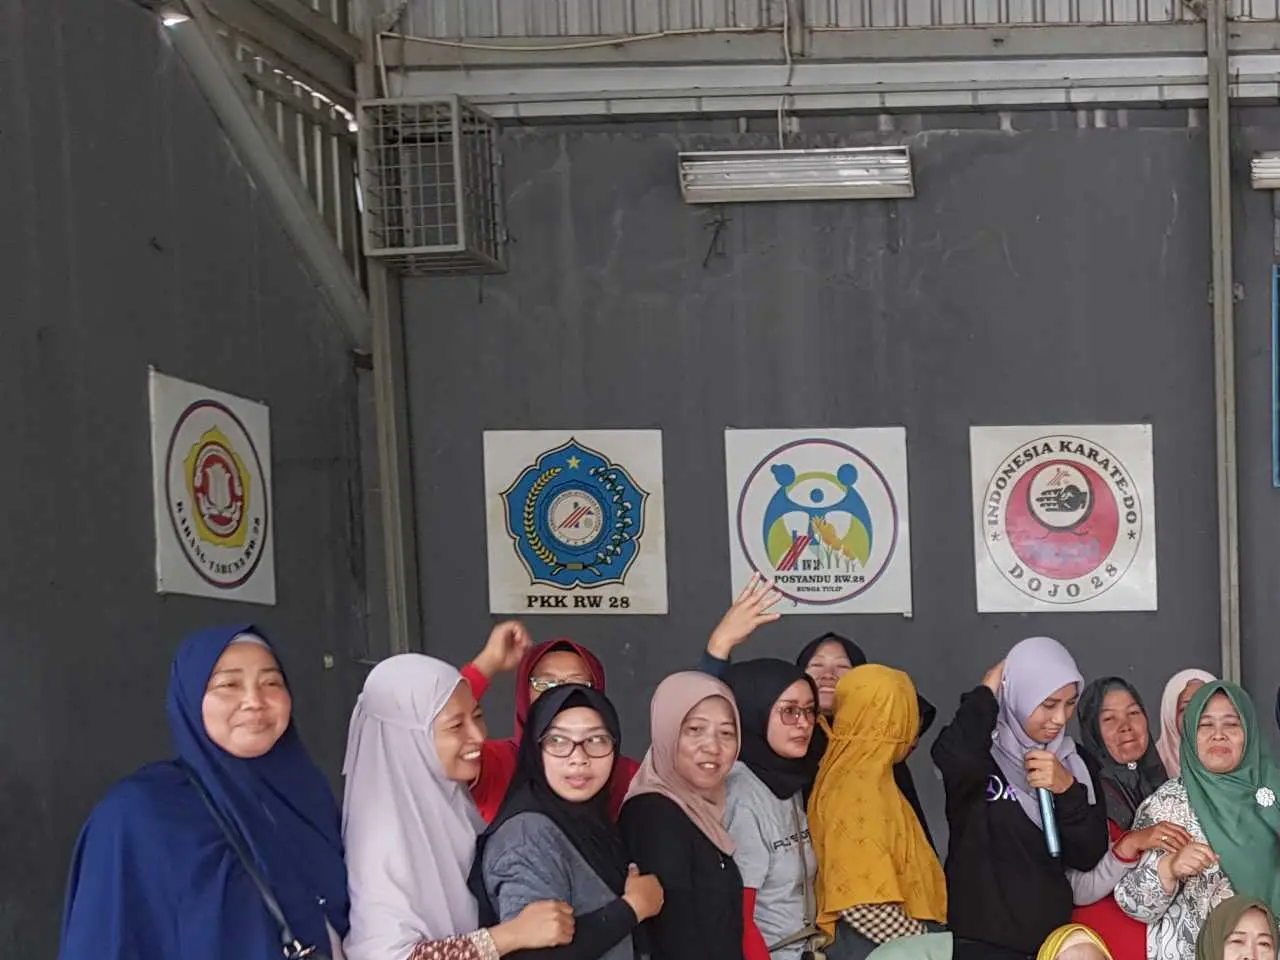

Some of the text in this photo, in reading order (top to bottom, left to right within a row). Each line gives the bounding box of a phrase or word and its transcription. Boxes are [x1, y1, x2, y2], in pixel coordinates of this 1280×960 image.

[987, 442, 1053, 526] INDONESIA
[1059, 440, 1138, 525] KARATE-DO
[775, 575, 831, 583] POSYANDU
[1008, 563, 1118, 598] DOJO 28
[527, 595, 630, 608] PKK RW 28
